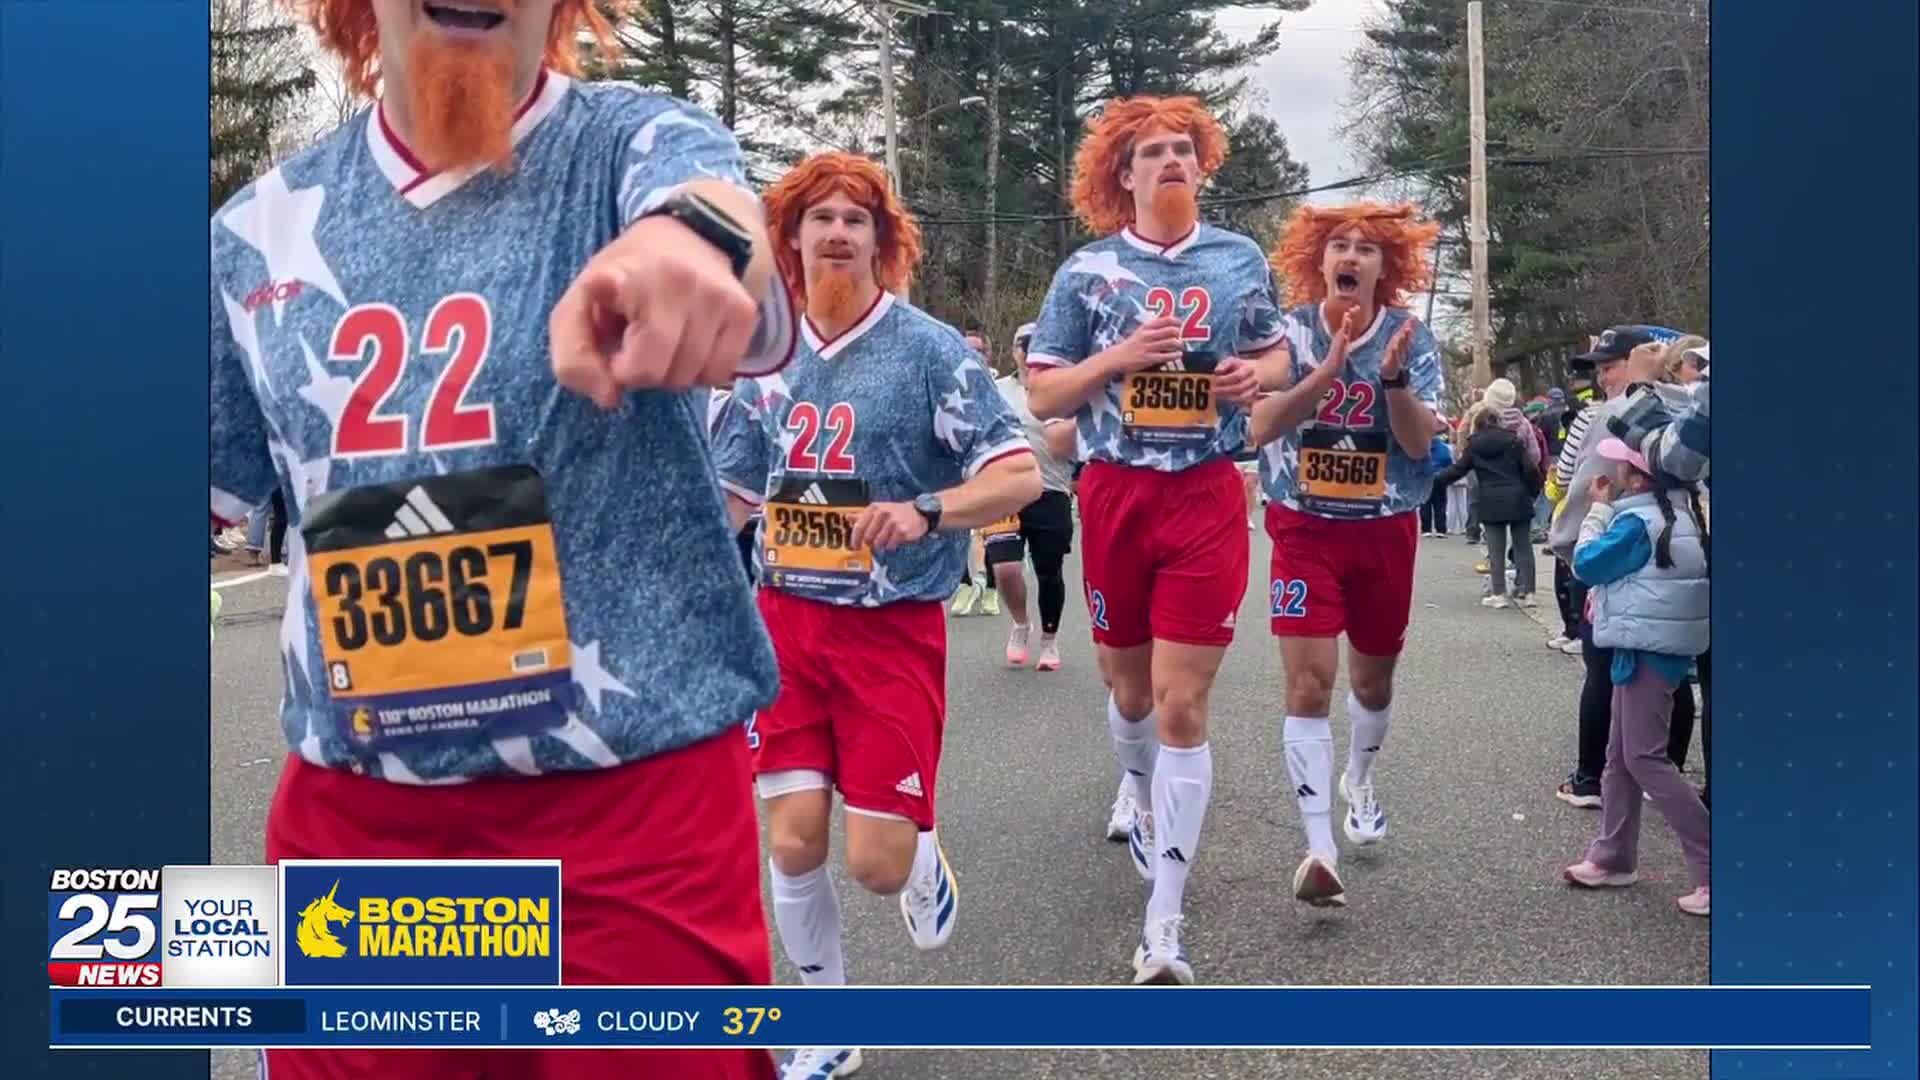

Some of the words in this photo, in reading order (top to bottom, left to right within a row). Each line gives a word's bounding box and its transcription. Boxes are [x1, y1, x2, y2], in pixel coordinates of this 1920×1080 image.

[327, 292, 496, 459] 22
[1130, 375, 1210, 411] 33566
[1316, 378, 1376, 429] 22
[786, 401, 856, 474] 22
[1306, 452, 1379, 485] 33569
[325, 541, 533, 651] 33667
[1271, 578, 1308, 618] 22
[332, 662, 348, 689] 8
[407, 703, 464, 723] BOSTON
[465, 687, 551, 716] MARATHON
